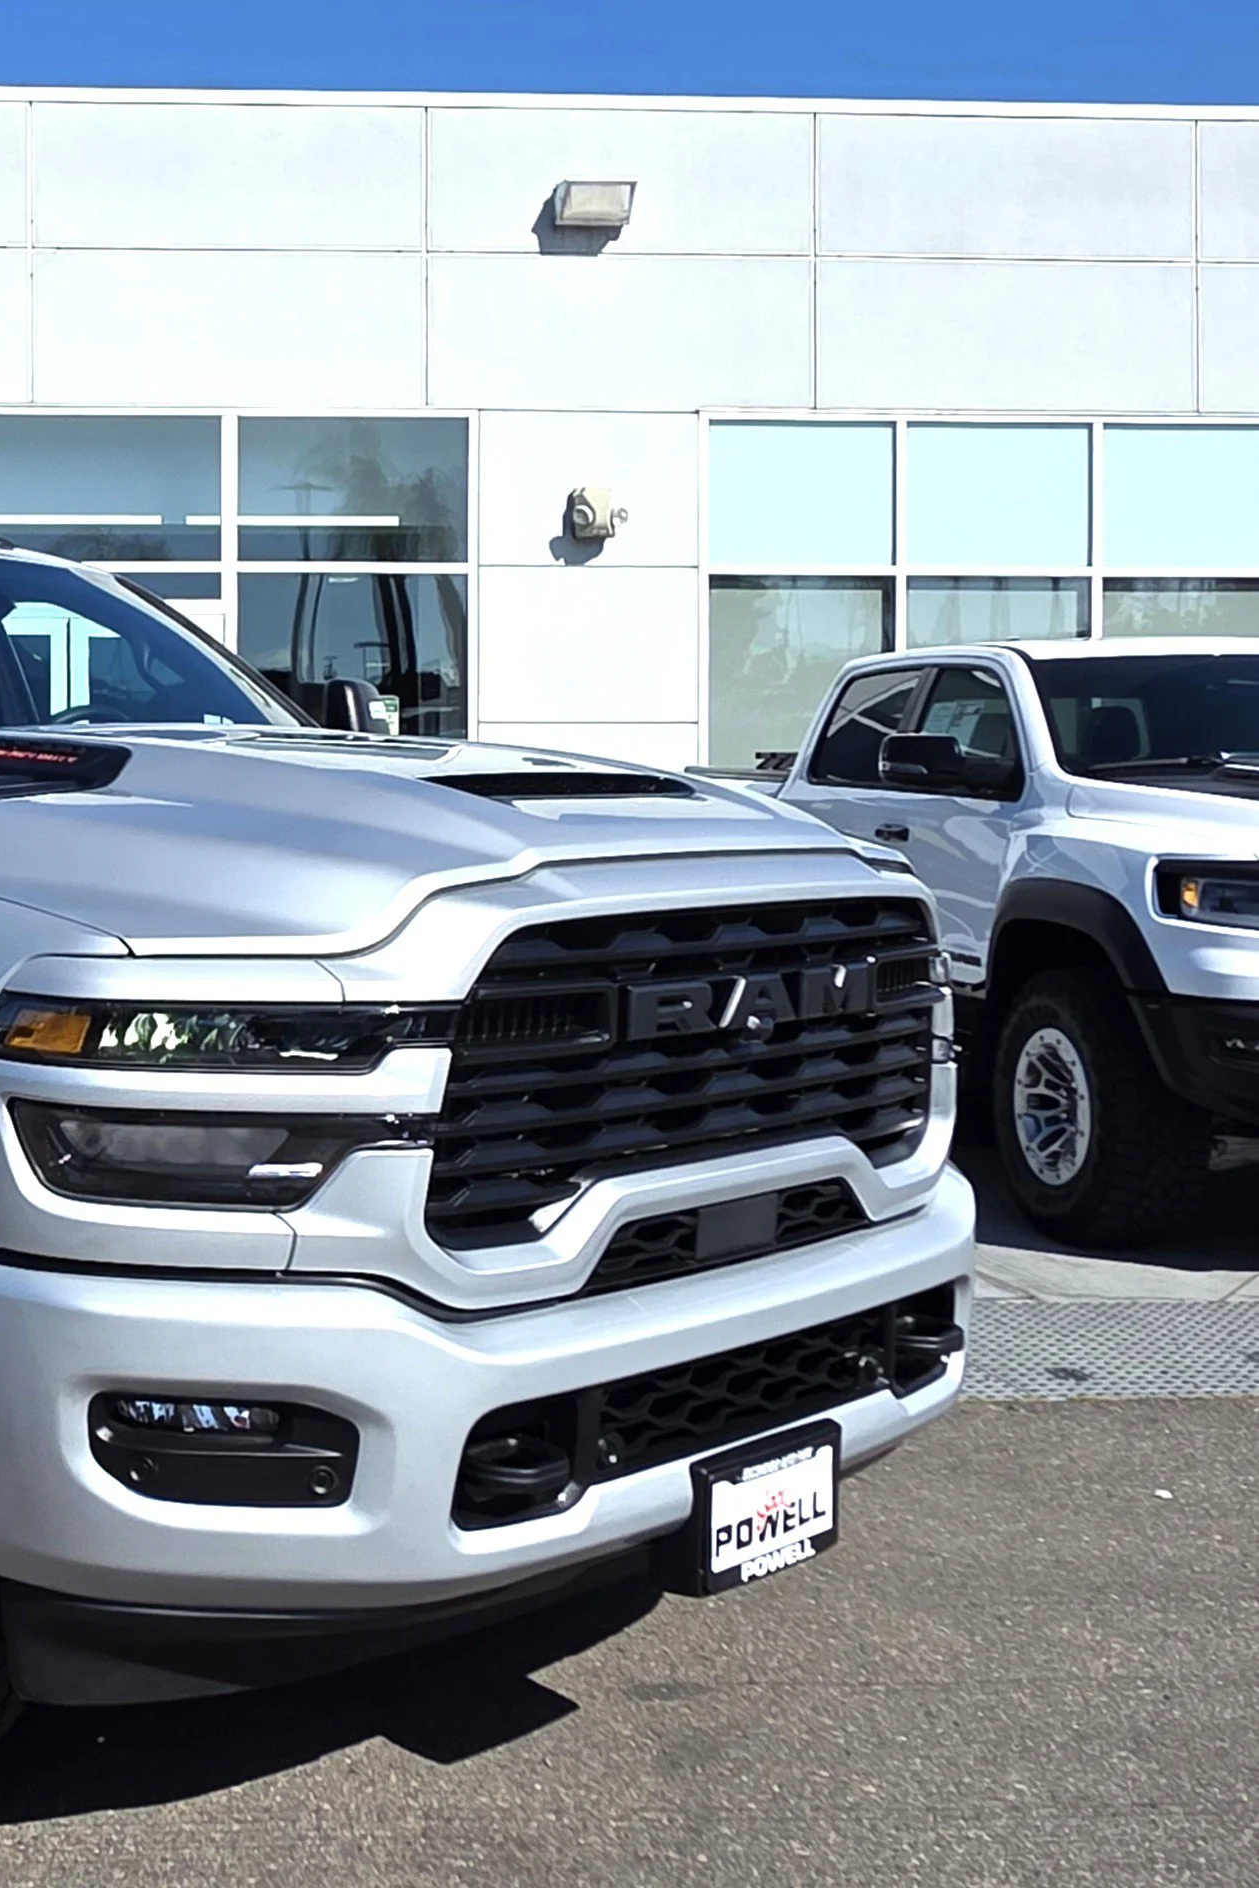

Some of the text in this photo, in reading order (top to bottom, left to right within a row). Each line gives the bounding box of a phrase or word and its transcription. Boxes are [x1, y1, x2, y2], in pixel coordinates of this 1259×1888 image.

[627, 963, 870, 1042] RAM
[716, 1492, 827, 1557] POWELL
[740, 1538, 817, 1583] POWELL
